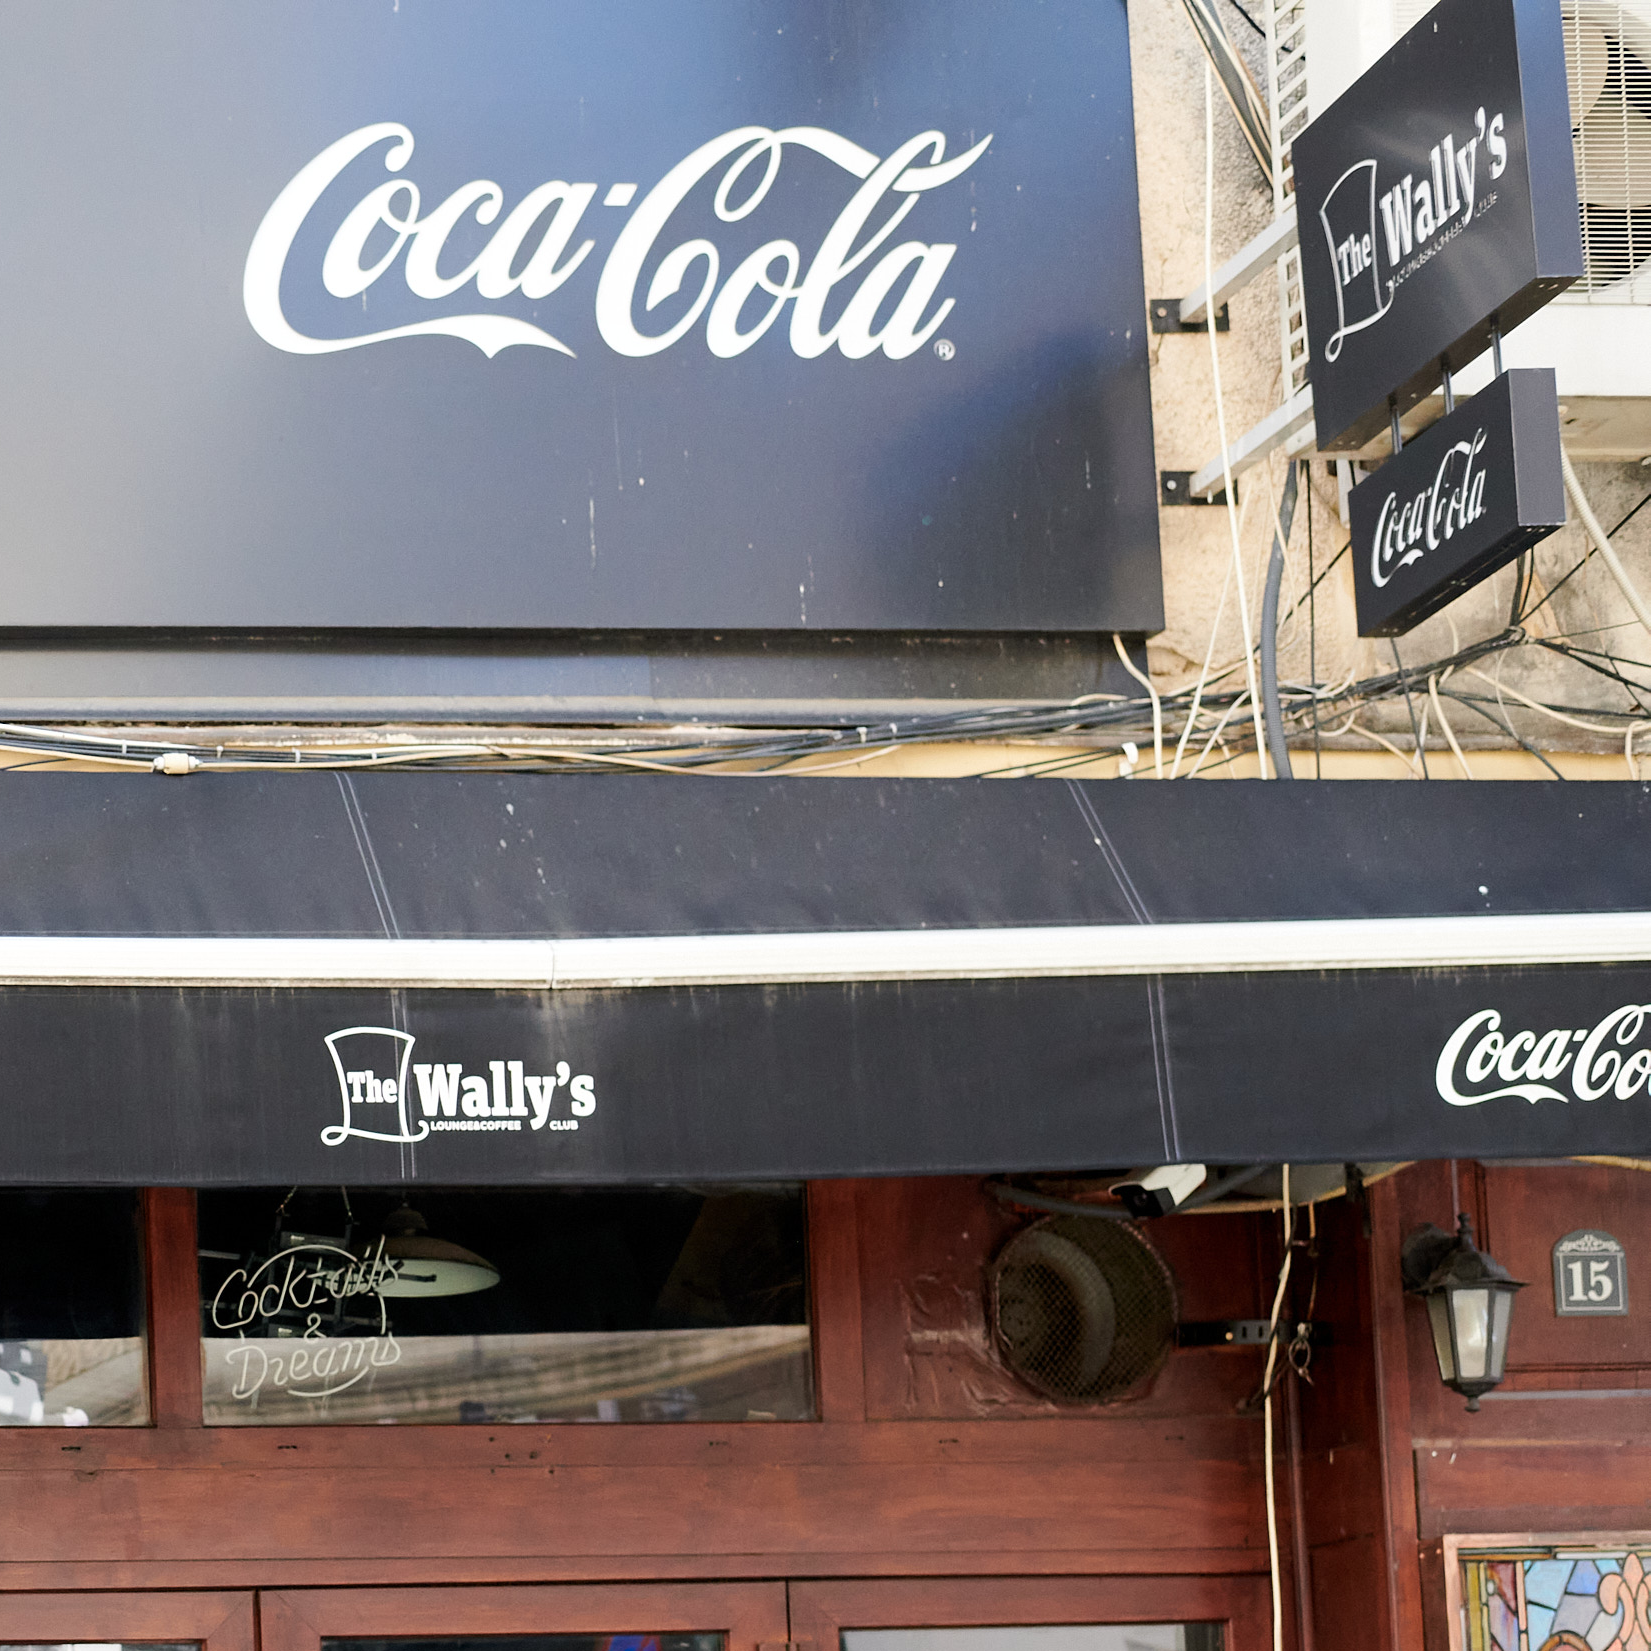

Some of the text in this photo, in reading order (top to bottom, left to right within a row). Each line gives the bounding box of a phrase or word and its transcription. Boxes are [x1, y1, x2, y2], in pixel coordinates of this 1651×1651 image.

[1337, 231, 1372, 285] The
[1380, 107, 1507, 268] Wally's
[243, 121, 993, 361] Coca-Cola
[1371, 426, 1487, 588] Coca-Cola
[1435, 1004, 1651, 1106] Coca-Co
[347, 1061, 596, 1130] The Wally's
[430, 1120, 579, 1131] LOUNGE&COFFEE CLUB
[1567, 1260, 1614, 1302] 15
[303, 1312, 328, 1344] &
[225, 1331, 402, 1399] Dreams
